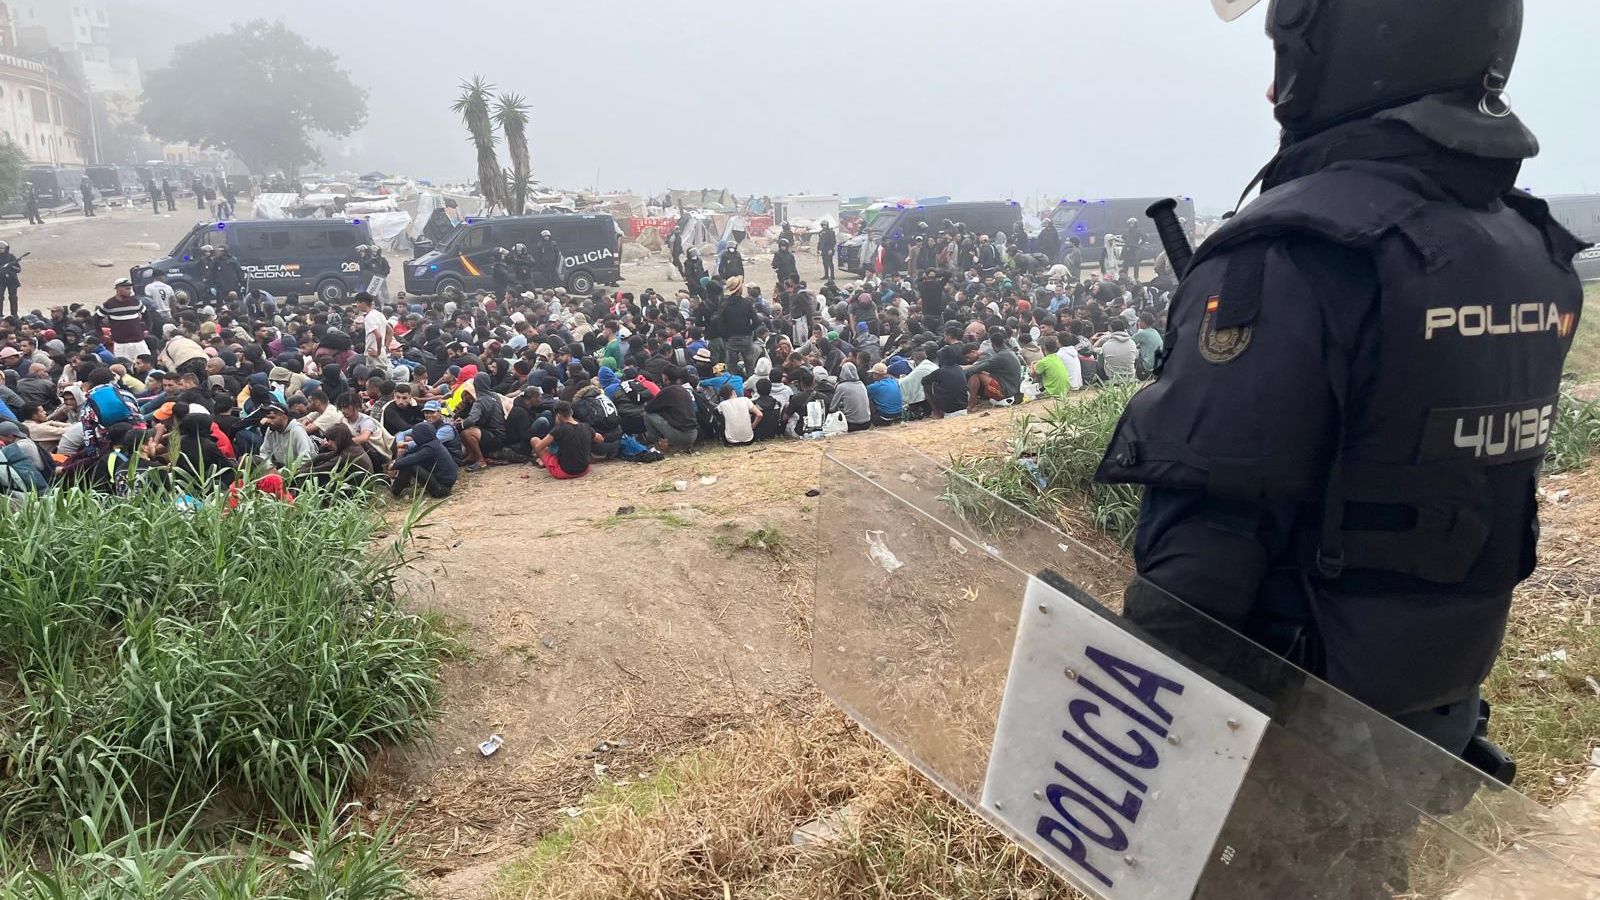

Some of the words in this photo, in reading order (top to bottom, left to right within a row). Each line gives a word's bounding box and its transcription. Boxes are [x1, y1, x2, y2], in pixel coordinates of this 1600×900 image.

[564, 248, 612, 267] OLICIA
[1425, 302, 1560, 340] POLICIA
[1454, 404, 1552, 457] 4U136
[1036, 645, 1185, 889] POLICIA
